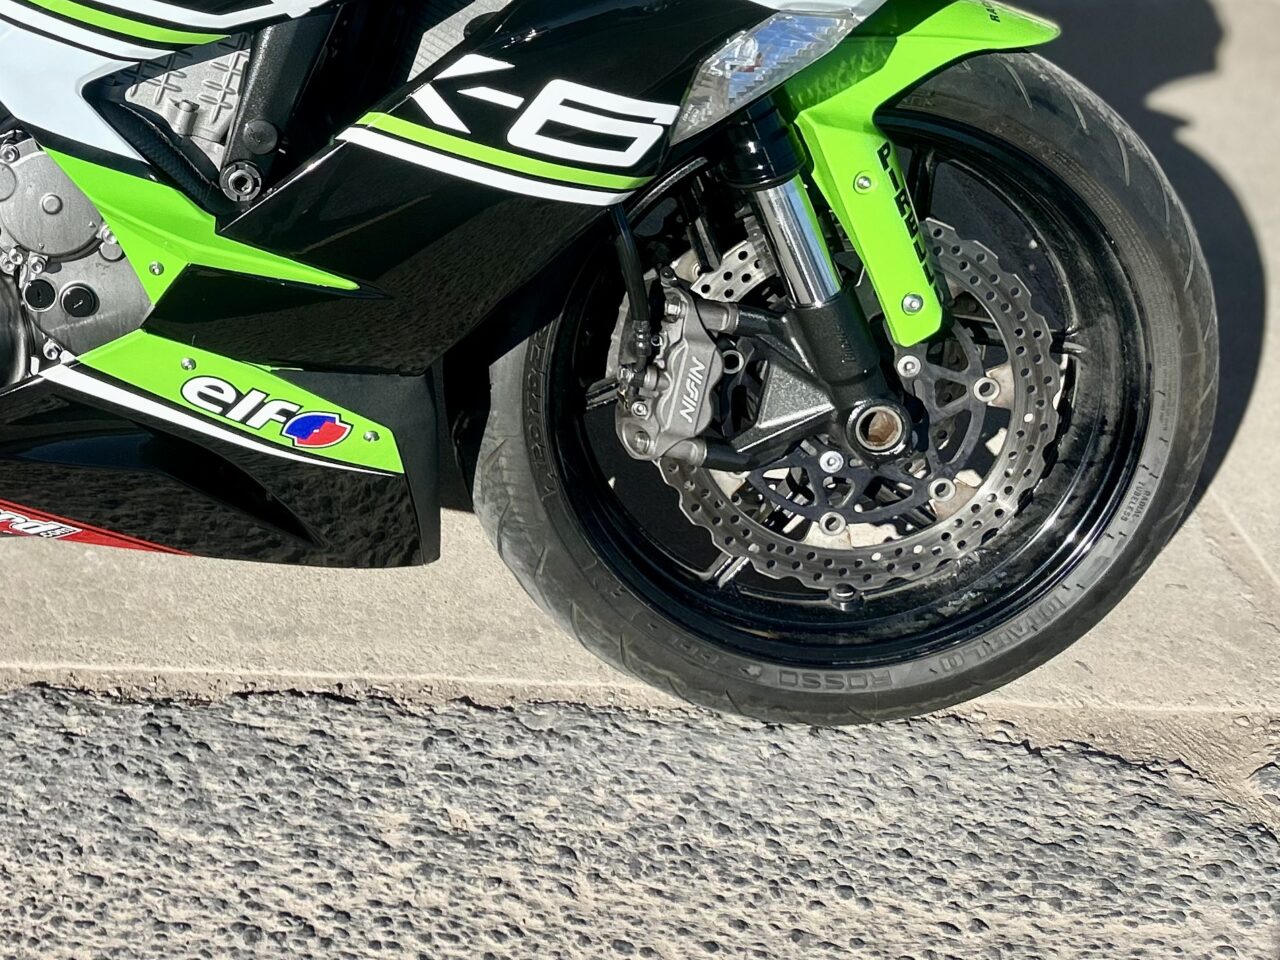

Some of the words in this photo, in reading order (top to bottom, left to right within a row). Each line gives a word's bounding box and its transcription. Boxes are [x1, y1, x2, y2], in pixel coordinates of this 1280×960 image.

[876, 141, 943, 310] PIRELLI
[180, 376, 303, 430] elf
[679, 355, 706, 424] NISSIN
[778, 669, 893, 691] ROSSO
